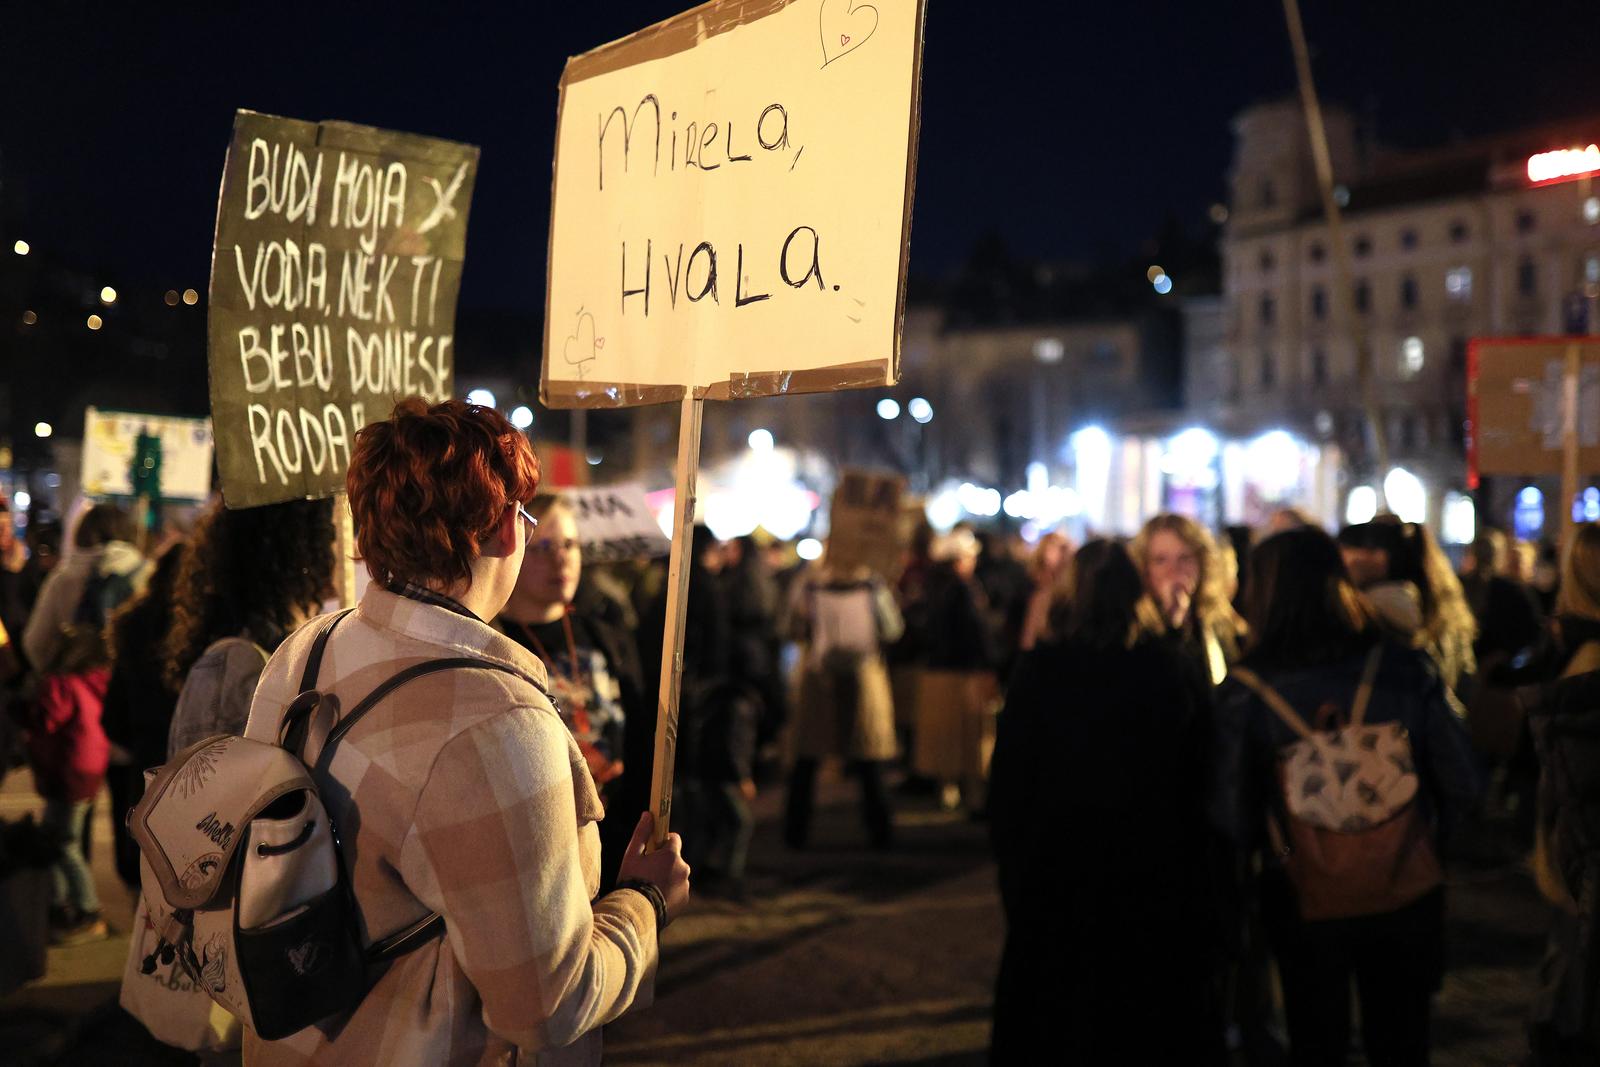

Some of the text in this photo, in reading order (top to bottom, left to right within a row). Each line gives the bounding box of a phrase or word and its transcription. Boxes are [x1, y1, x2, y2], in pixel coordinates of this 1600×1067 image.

[244, 137, 407, 253] BUDI MOJA
[234, 238, 442, 327] VODA, NEK TI
[238, 322, 453, 401] BEBU DONESE
